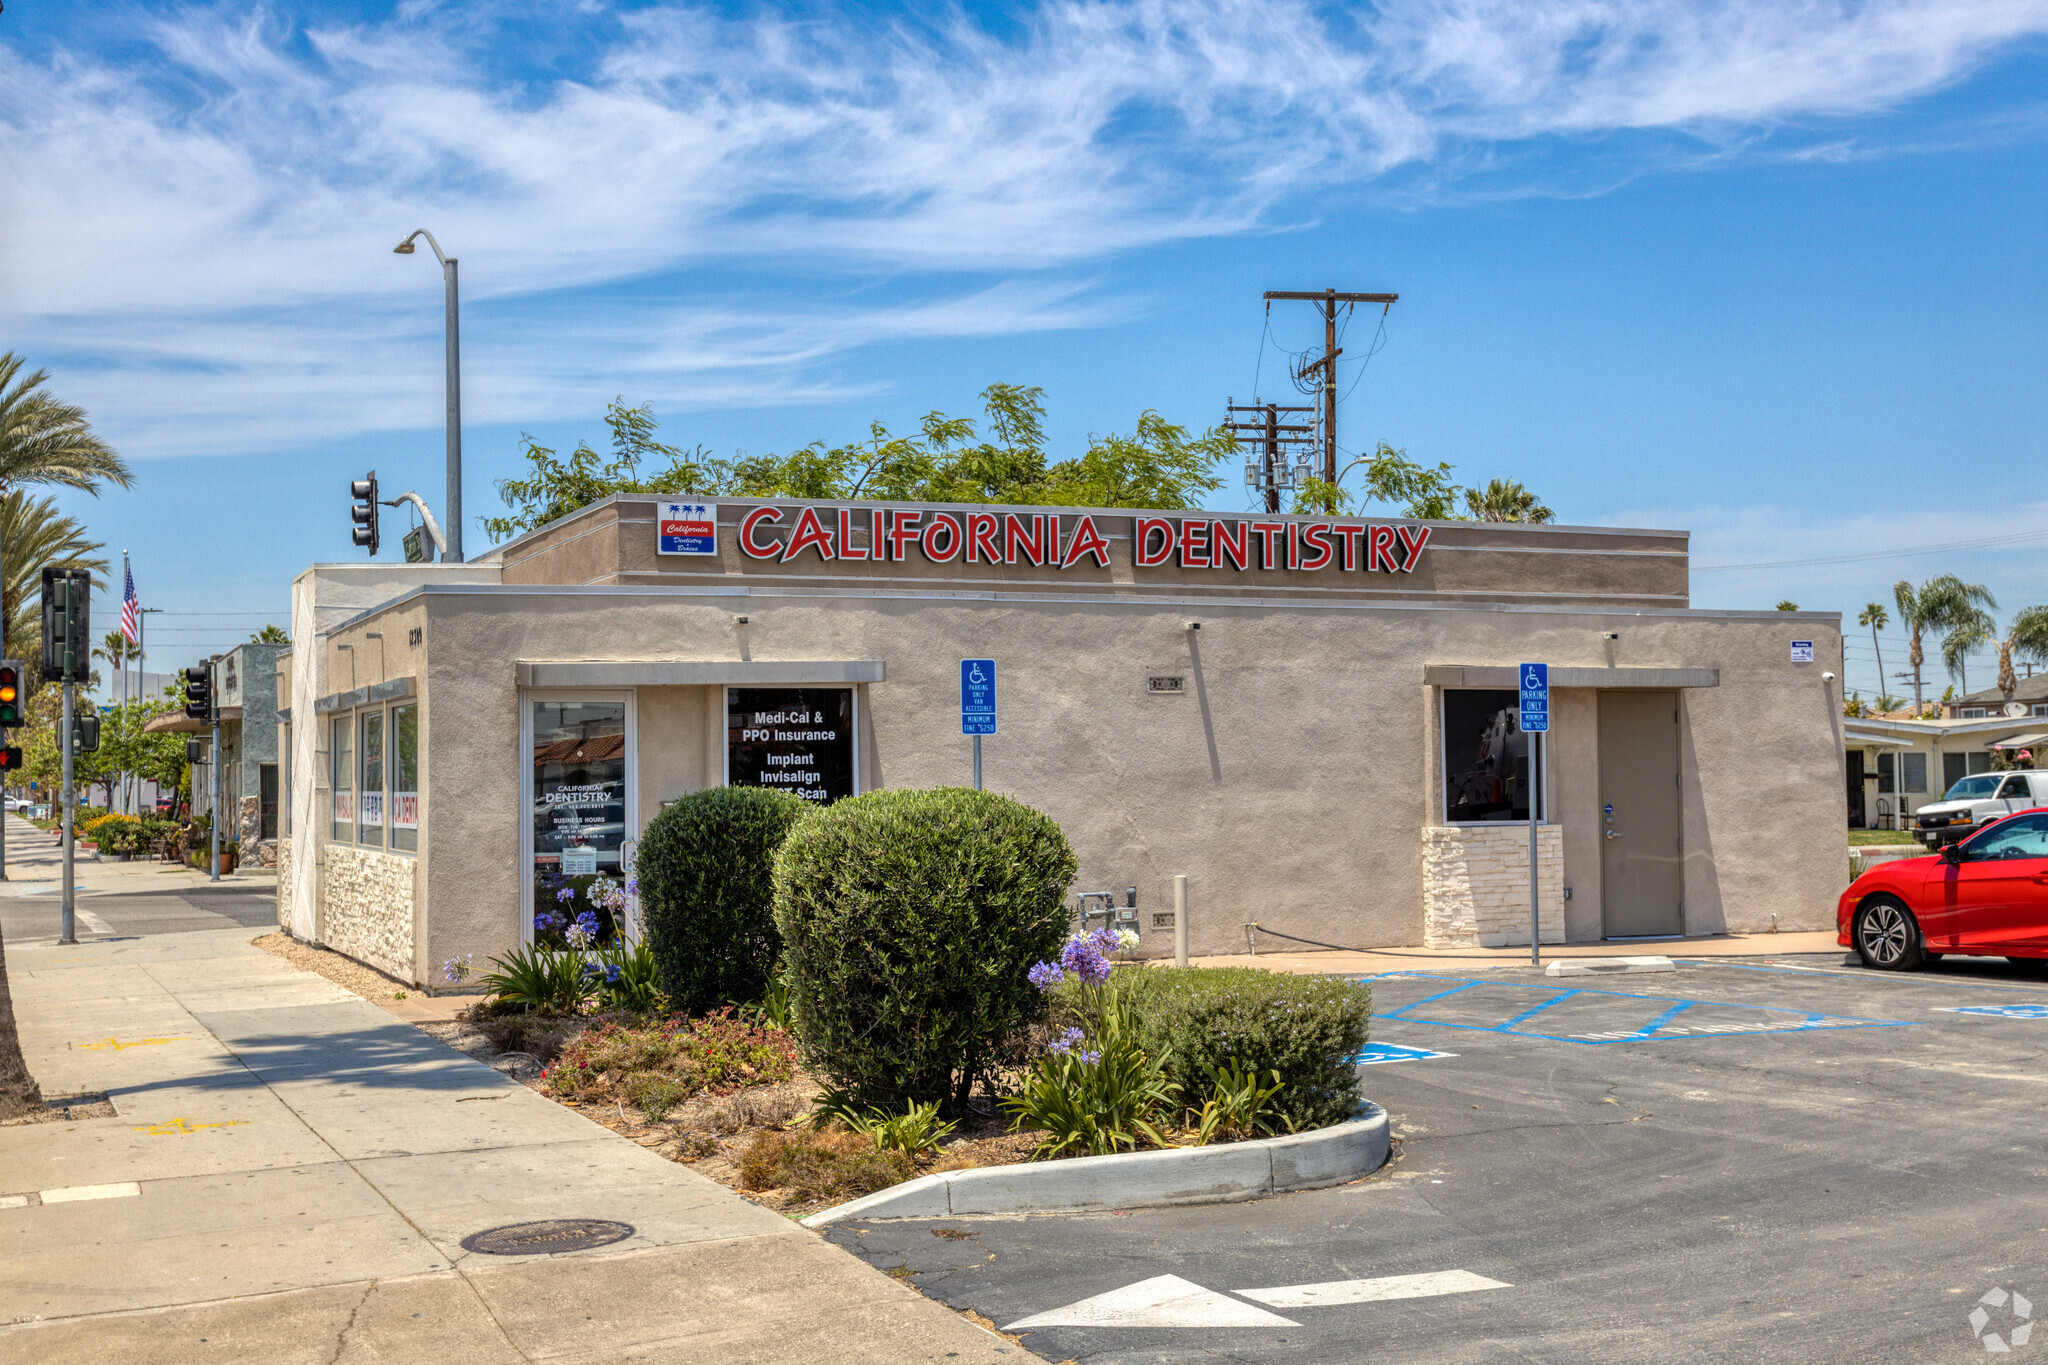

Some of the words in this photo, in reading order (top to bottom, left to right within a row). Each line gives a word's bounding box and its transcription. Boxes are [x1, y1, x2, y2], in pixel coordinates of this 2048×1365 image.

[666, 524, 709, 534] California
[673, 536, 702, 544] Dentistry
[739, 504, 1111, 569] CALIFORNIA
[1134, 516, 1432, 573] DENTISTRY
[1522, 690, 1547, 700] PARKING
[1526, 701, 1542, 711] ONLY
[755, 711, 809, 724] Medi-Cal
[814, 711, 823, 723] &
[964, 724, 975, 732] FINE
[979, 724, 994, 732] $250
[743, 729, 770, 741] PPO
[774, 729, 836, 741] Insurance
[767, 753, 814, 768] Implant
[760, 771, 821, 785] Invisalign
[545, 791, 612, 803] DENTISTRY
[797, 788, 827, 800] Scan
